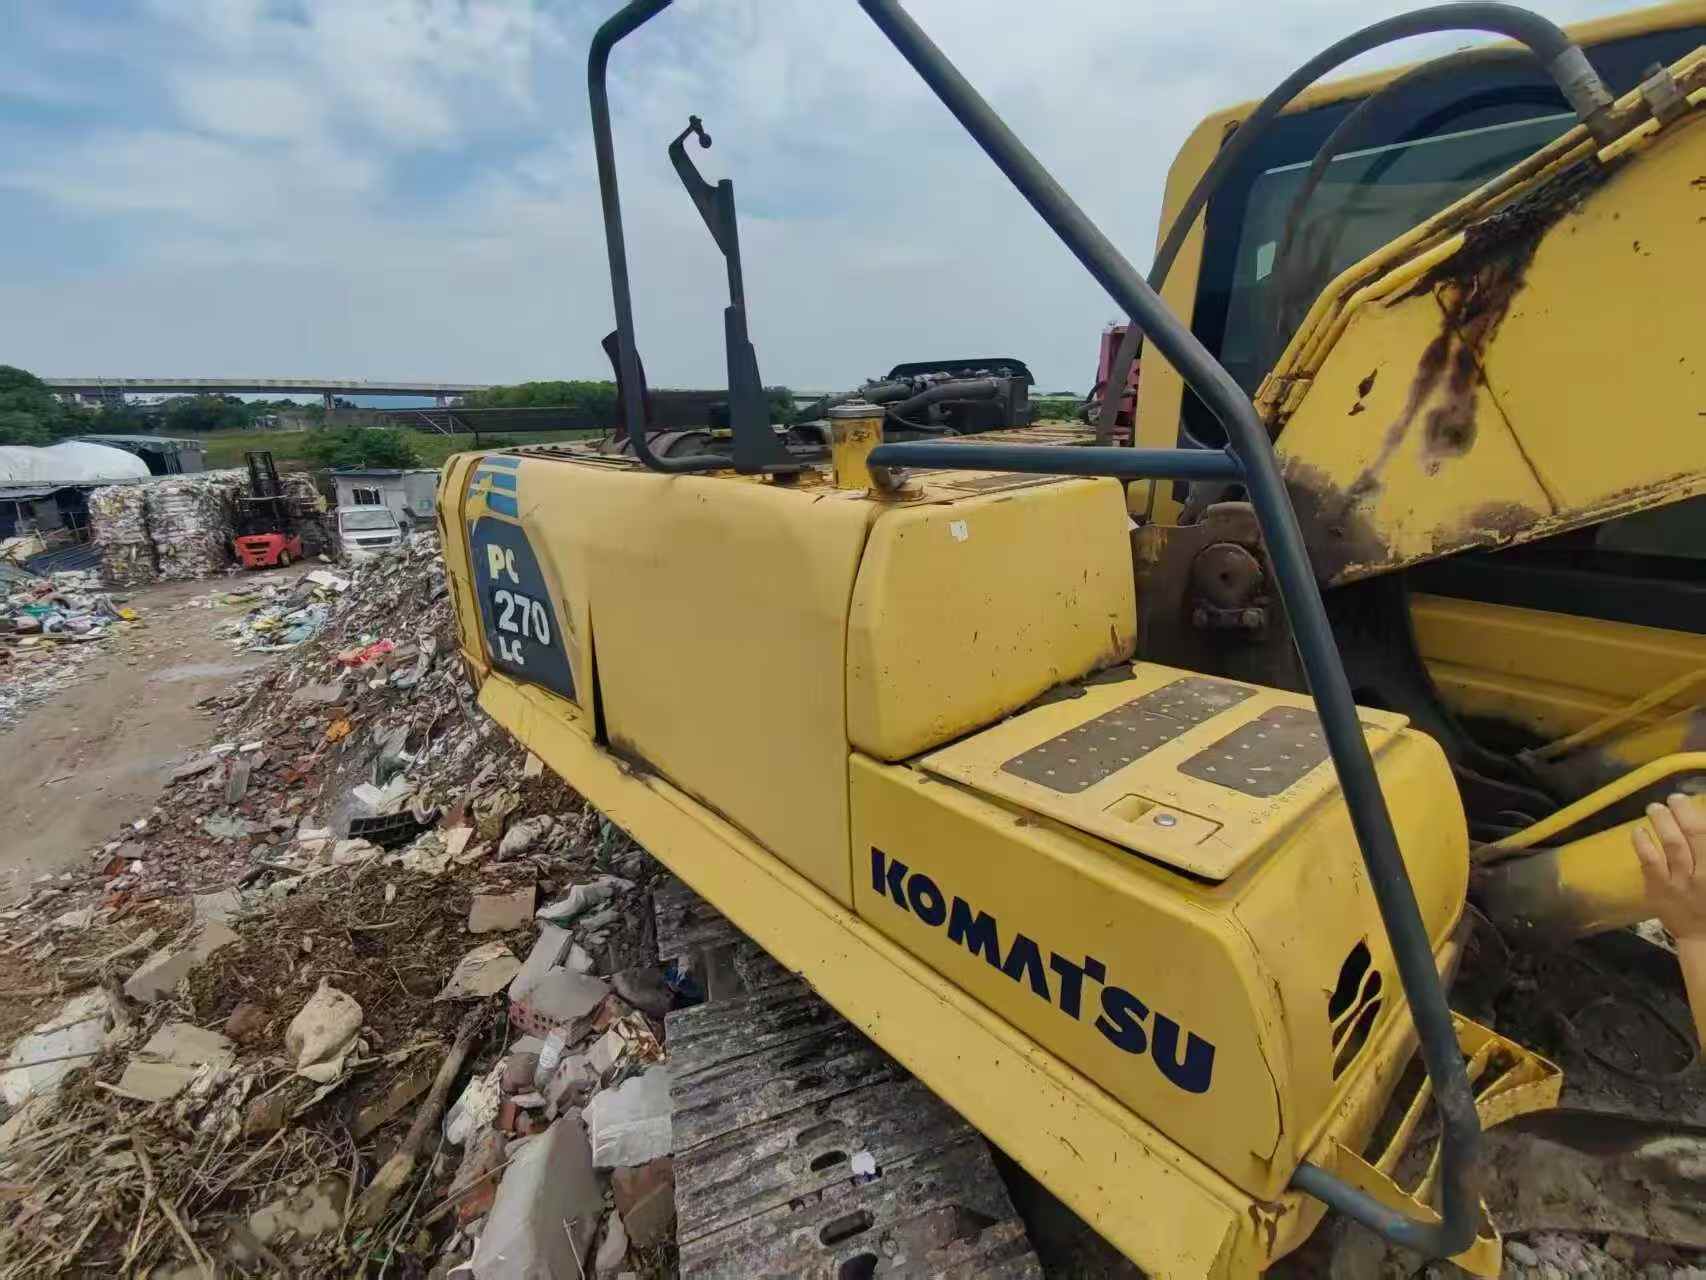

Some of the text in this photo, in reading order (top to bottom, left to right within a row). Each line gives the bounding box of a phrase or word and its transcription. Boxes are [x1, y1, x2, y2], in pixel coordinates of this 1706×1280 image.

[487, 544, 520, 584] PC
[495, 590, 550, 645] 270
[500, 636, 524, 665] LC
[871, 846, 1215, 1093] KOMATSU
